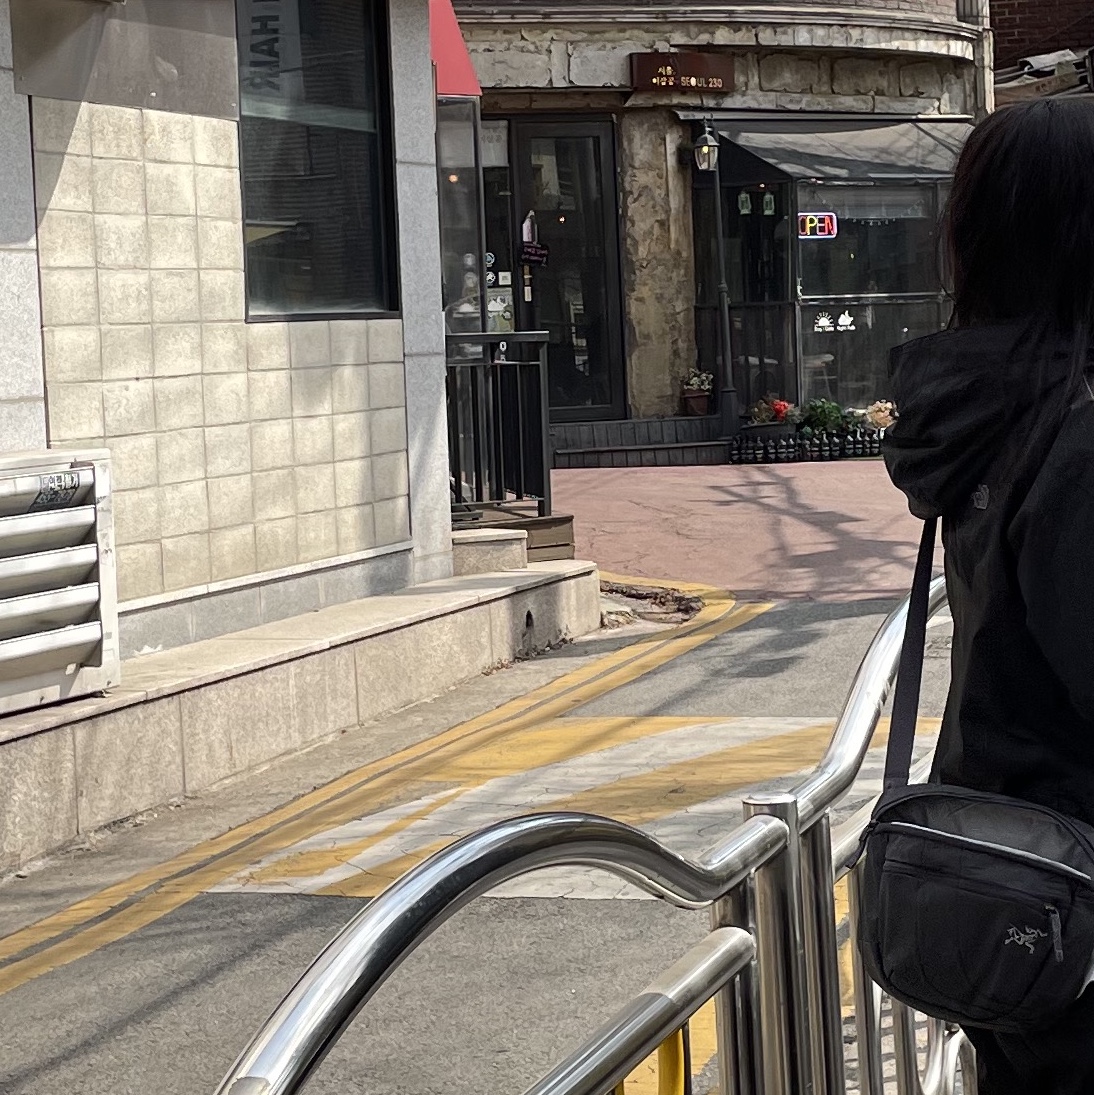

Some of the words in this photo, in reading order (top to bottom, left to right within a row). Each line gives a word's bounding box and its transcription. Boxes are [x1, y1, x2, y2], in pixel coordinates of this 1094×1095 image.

[680, 76, 708, 88] SEOUL
[708, 77, 723, 88] 230
[799, 214, 836, 236] OPEN
